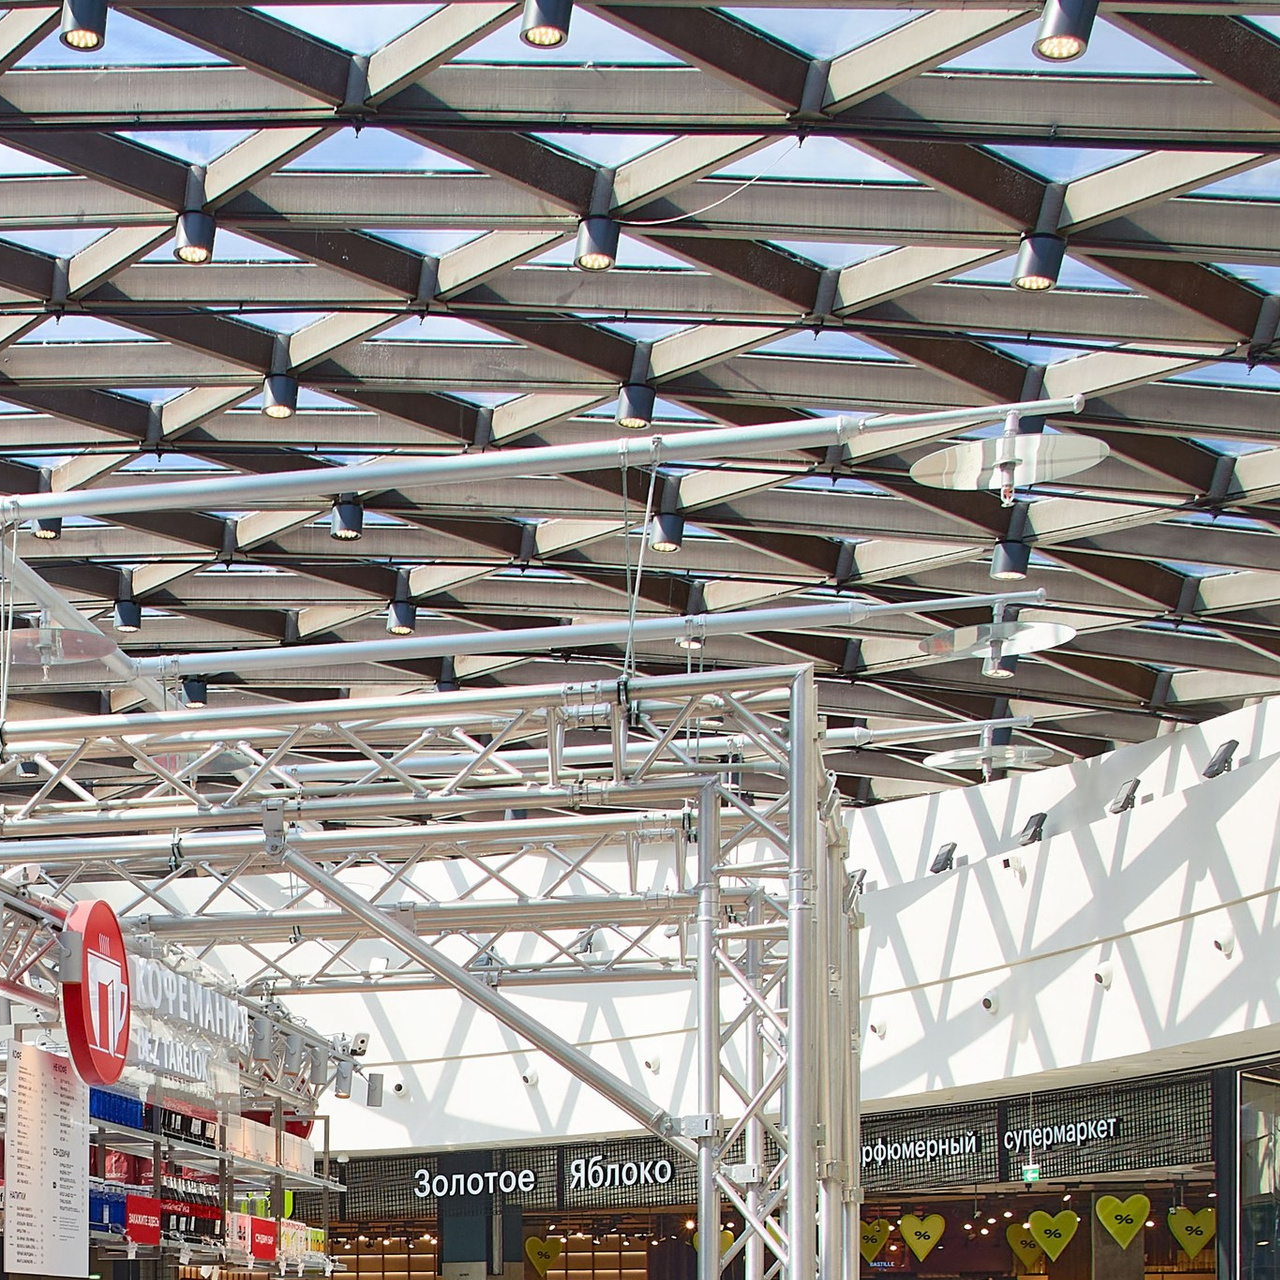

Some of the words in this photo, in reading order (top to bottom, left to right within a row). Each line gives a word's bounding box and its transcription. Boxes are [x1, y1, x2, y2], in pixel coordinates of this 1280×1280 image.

[131, 955, 249, 1054] КОФЕМАНИЯ
[138, 1026, 160, 1065] BEZ
[164, 1040, 209, 1083] TARELOK
[860, 1131, 977, 1167] рфюмерный
[1004, 1118, 1117, 1154] супермаркет
[413, 1168, 536, 1198] Золотое
[569, 1155, 672, 1189] Яблоко
